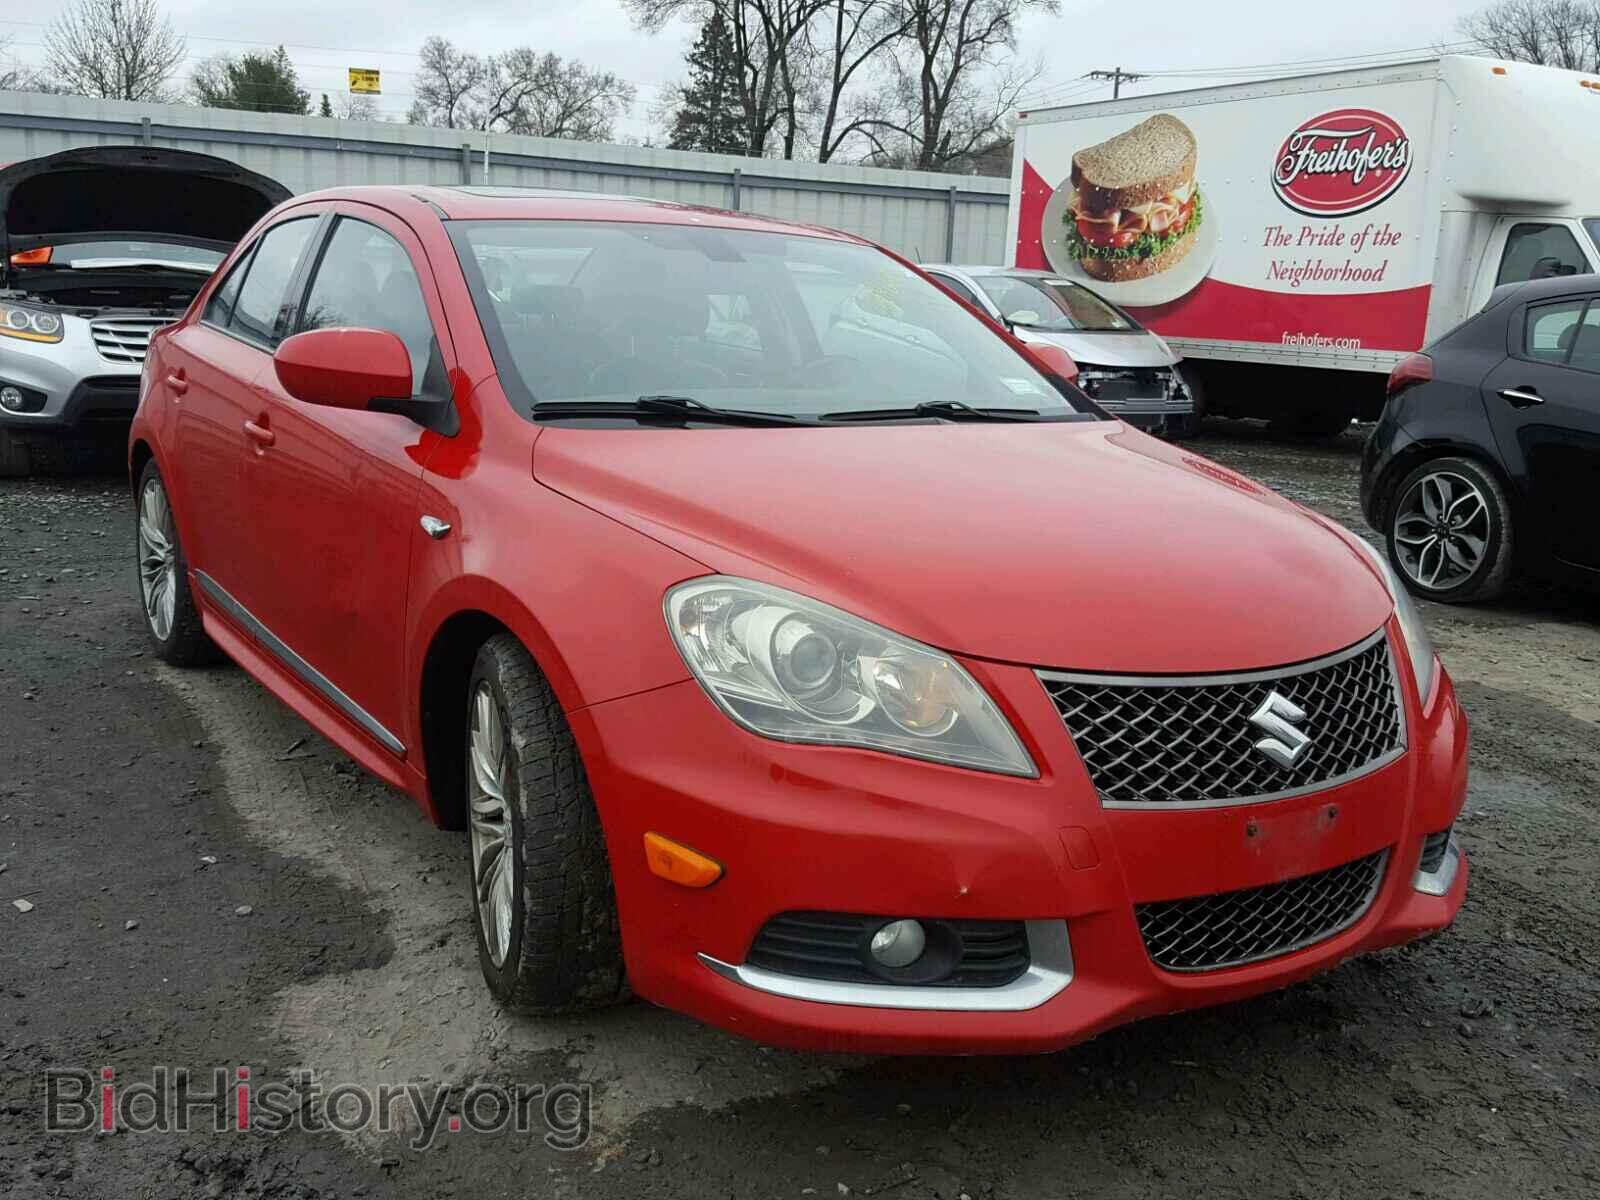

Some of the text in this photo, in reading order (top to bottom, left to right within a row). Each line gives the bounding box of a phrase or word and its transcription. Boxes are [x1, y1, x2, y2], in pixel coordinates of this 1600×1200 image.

[1275, 126, 1409, 185] Freihofer's
[1263, 223, 1402, 254] The Pride of the
[1266, 259, 1389, 288] Neighborhood
[1281, 330, 1361, 350] freihofers.com
